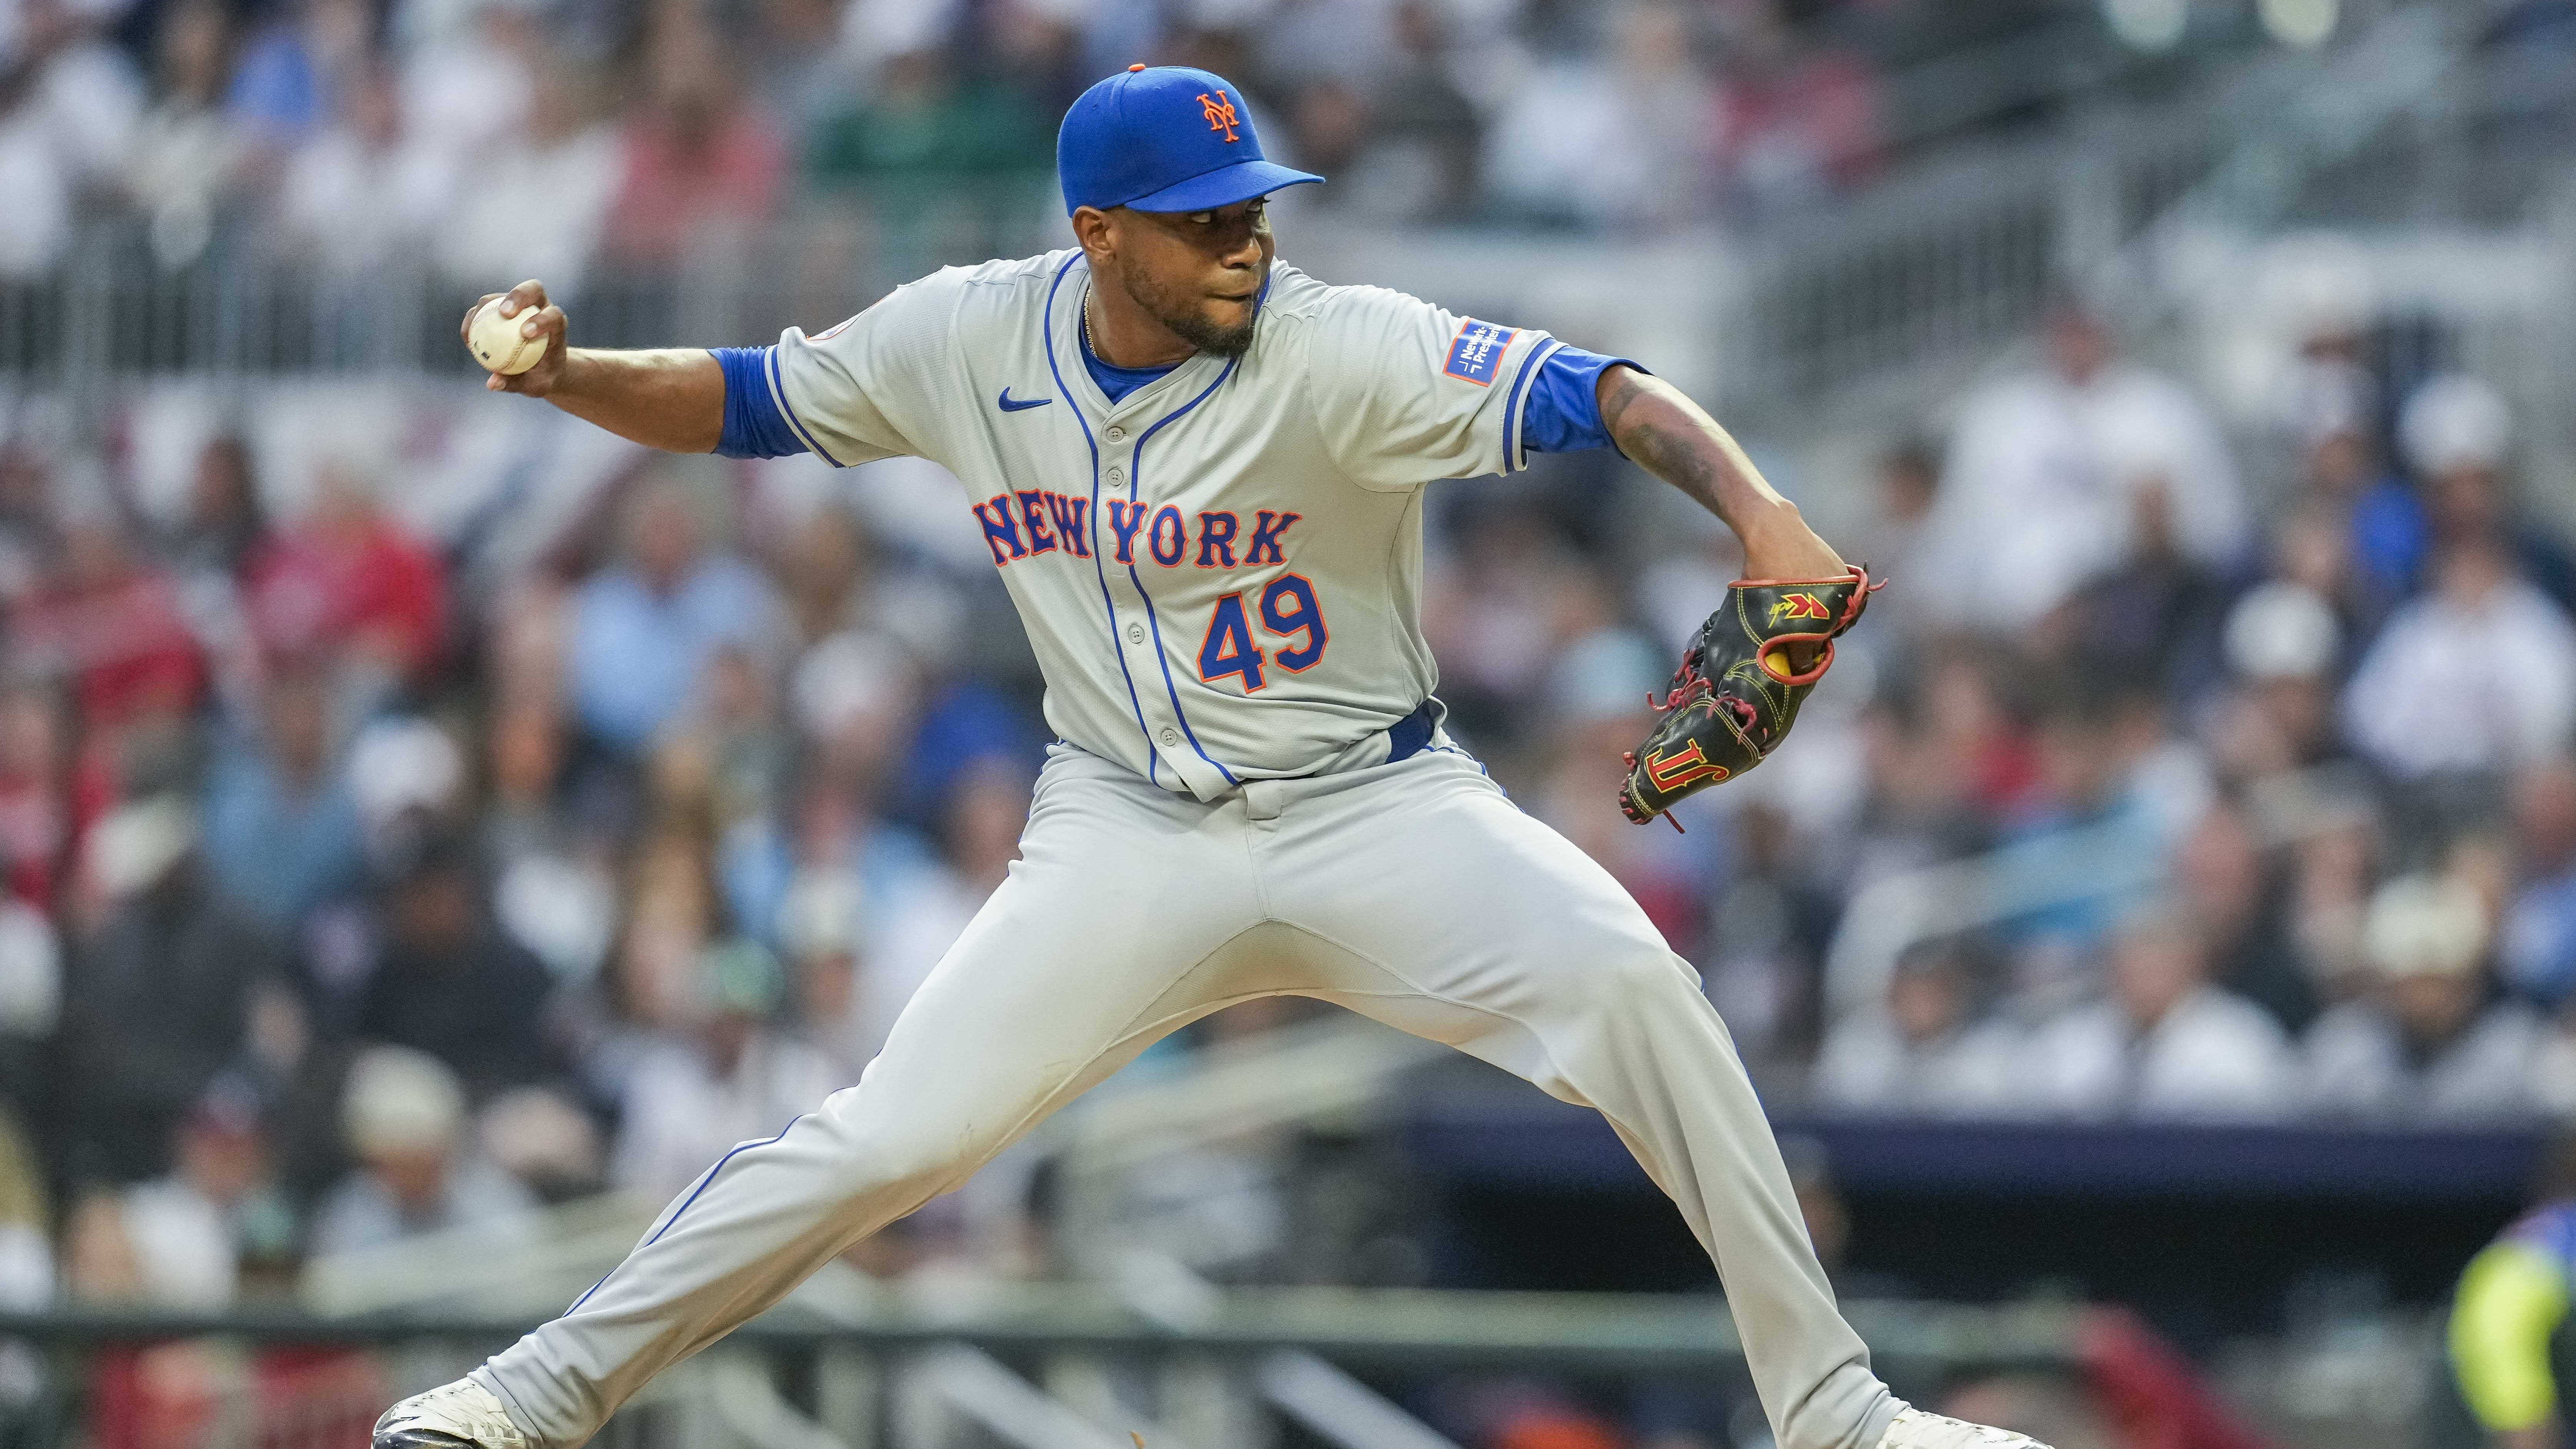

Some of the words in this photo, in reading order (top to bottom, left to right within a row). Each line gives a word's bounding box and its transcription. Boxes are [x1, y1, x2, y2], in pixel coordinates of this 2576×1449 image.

[972, 488, 1092, 568] NEW
[1106, 499, 1303, 569] YORK
[1196, 572, 1329, 694] 49
